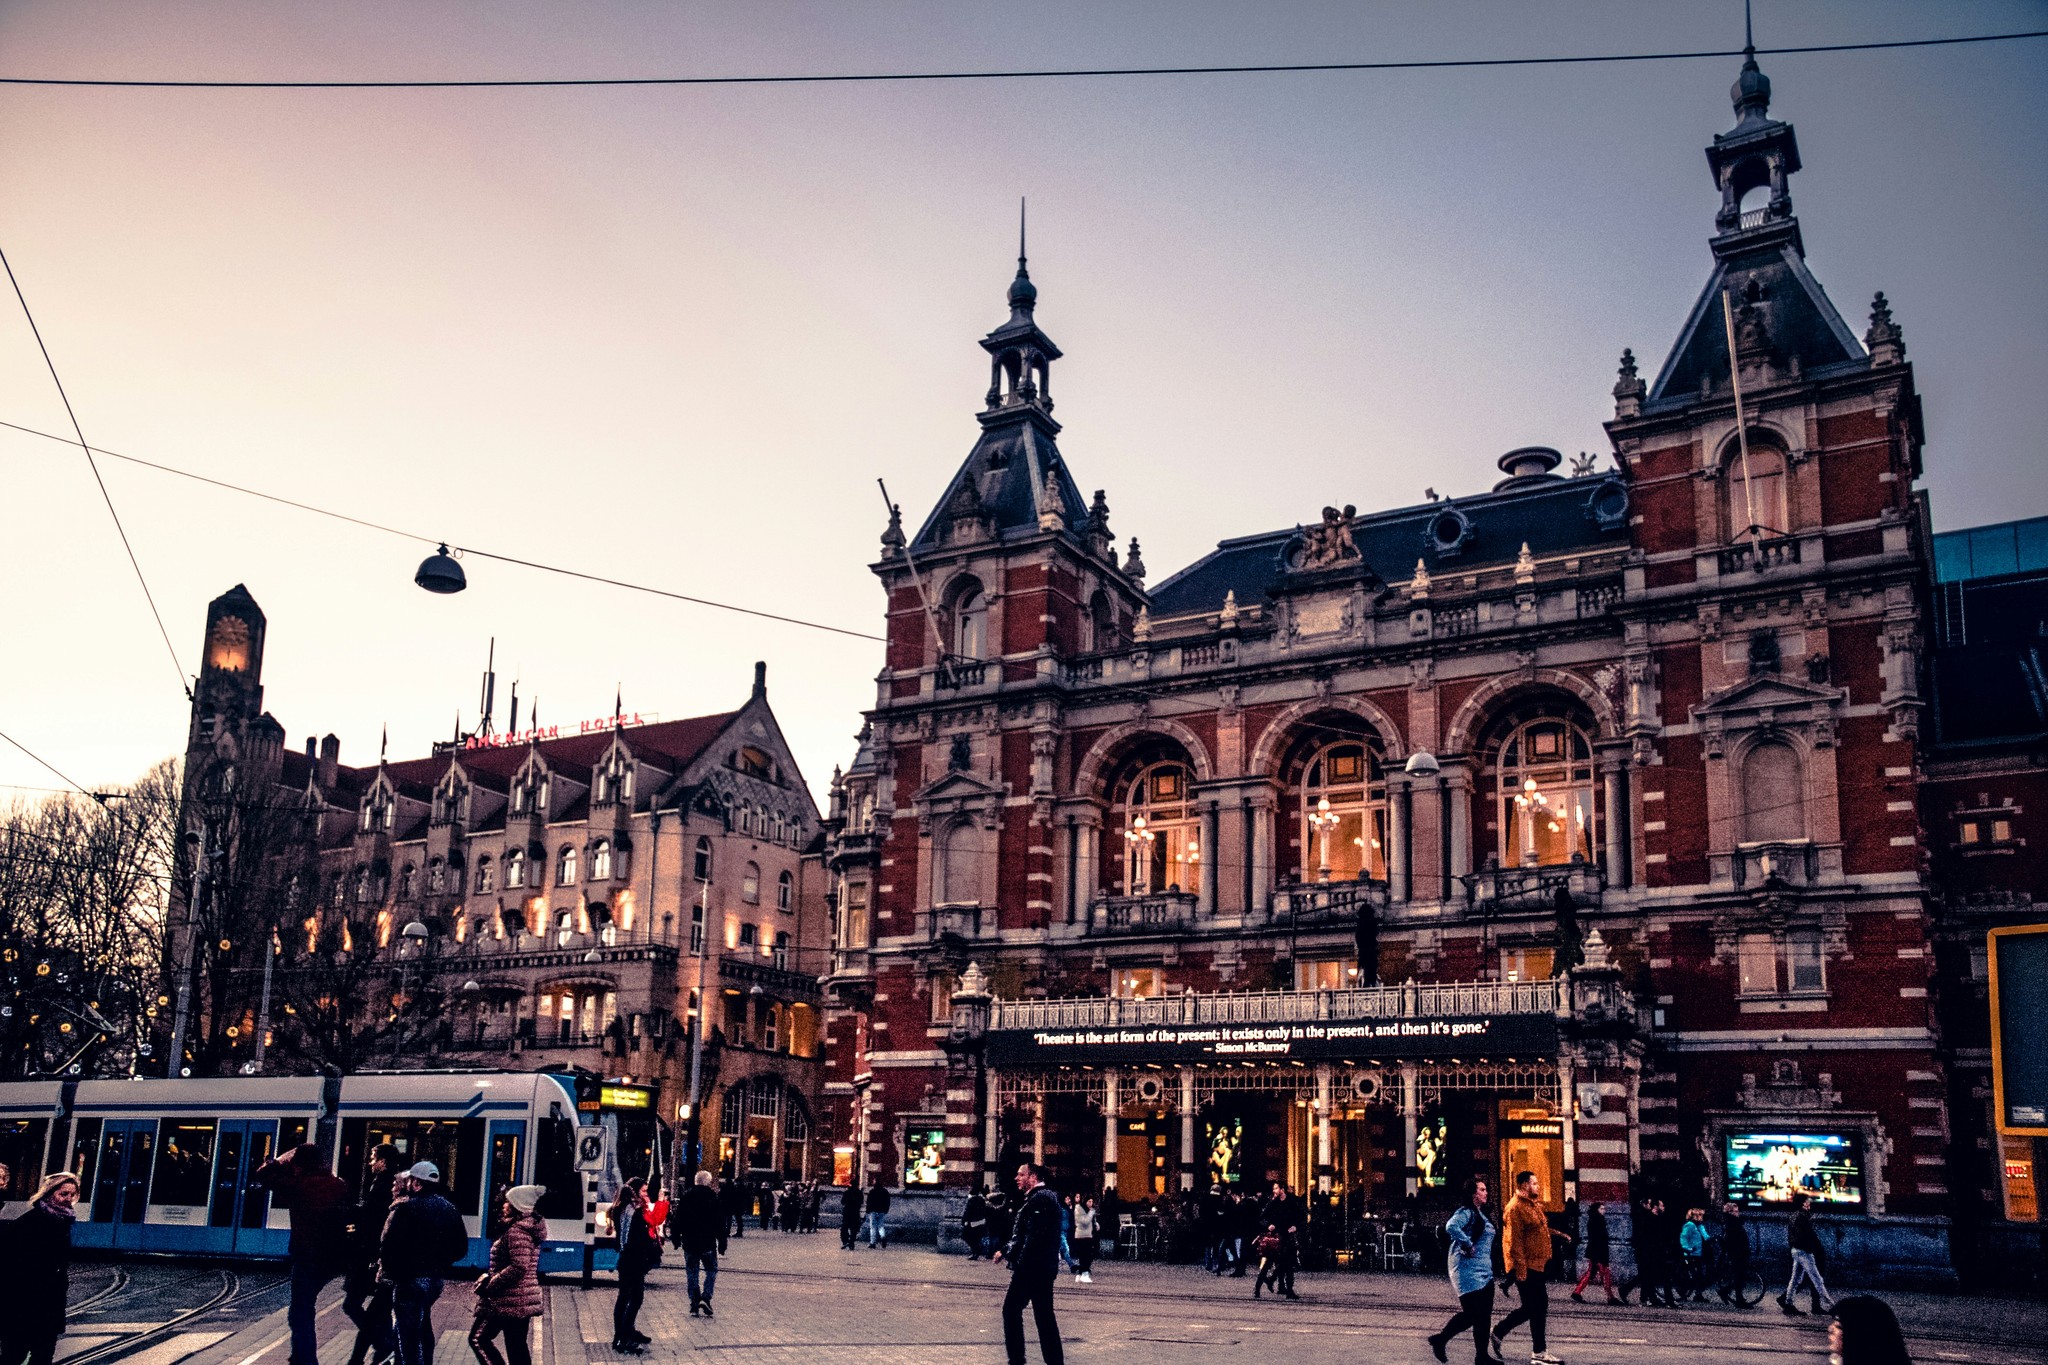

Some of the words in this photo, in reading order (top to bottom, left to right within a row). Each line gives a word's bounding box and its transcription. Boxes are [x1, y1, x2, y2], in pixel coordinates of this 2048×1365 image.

[465, 725, 559, 750] AMERICAN
[581, 712, 644, 732] HOTEL
[1075, 1033, 1084, 1044] is
[1086, 1032, 1103, 1044] the
[1104, 1032, 1118, 1043] art
[1120, 1031, 1144, 1043] form
[1146, 1030, 1158, 1042] of
[1158, 1030, 1176, 1042] the
[1177, 1030, 1220, 1045] present:
[1222, 1028, 1231, 1040] it
[1232, 1028, 1264, 1042] exists
[1265, 1026, 1290, 1041] only
[1292, 1026, 1304, 1038] in
[1306, 1025, 1325, 1038] the
[1327, 1025, 1374, 1040] present,
[1376, 1023, 1399, 1036] and
[1401, 1022, 1428, 1036] then
[1215, 1043, 1244, 1053] Simon
[1245, 1041, 1290, 1053] McBurney
[1521, 1124, 1560, 1134] BRASSERIE
